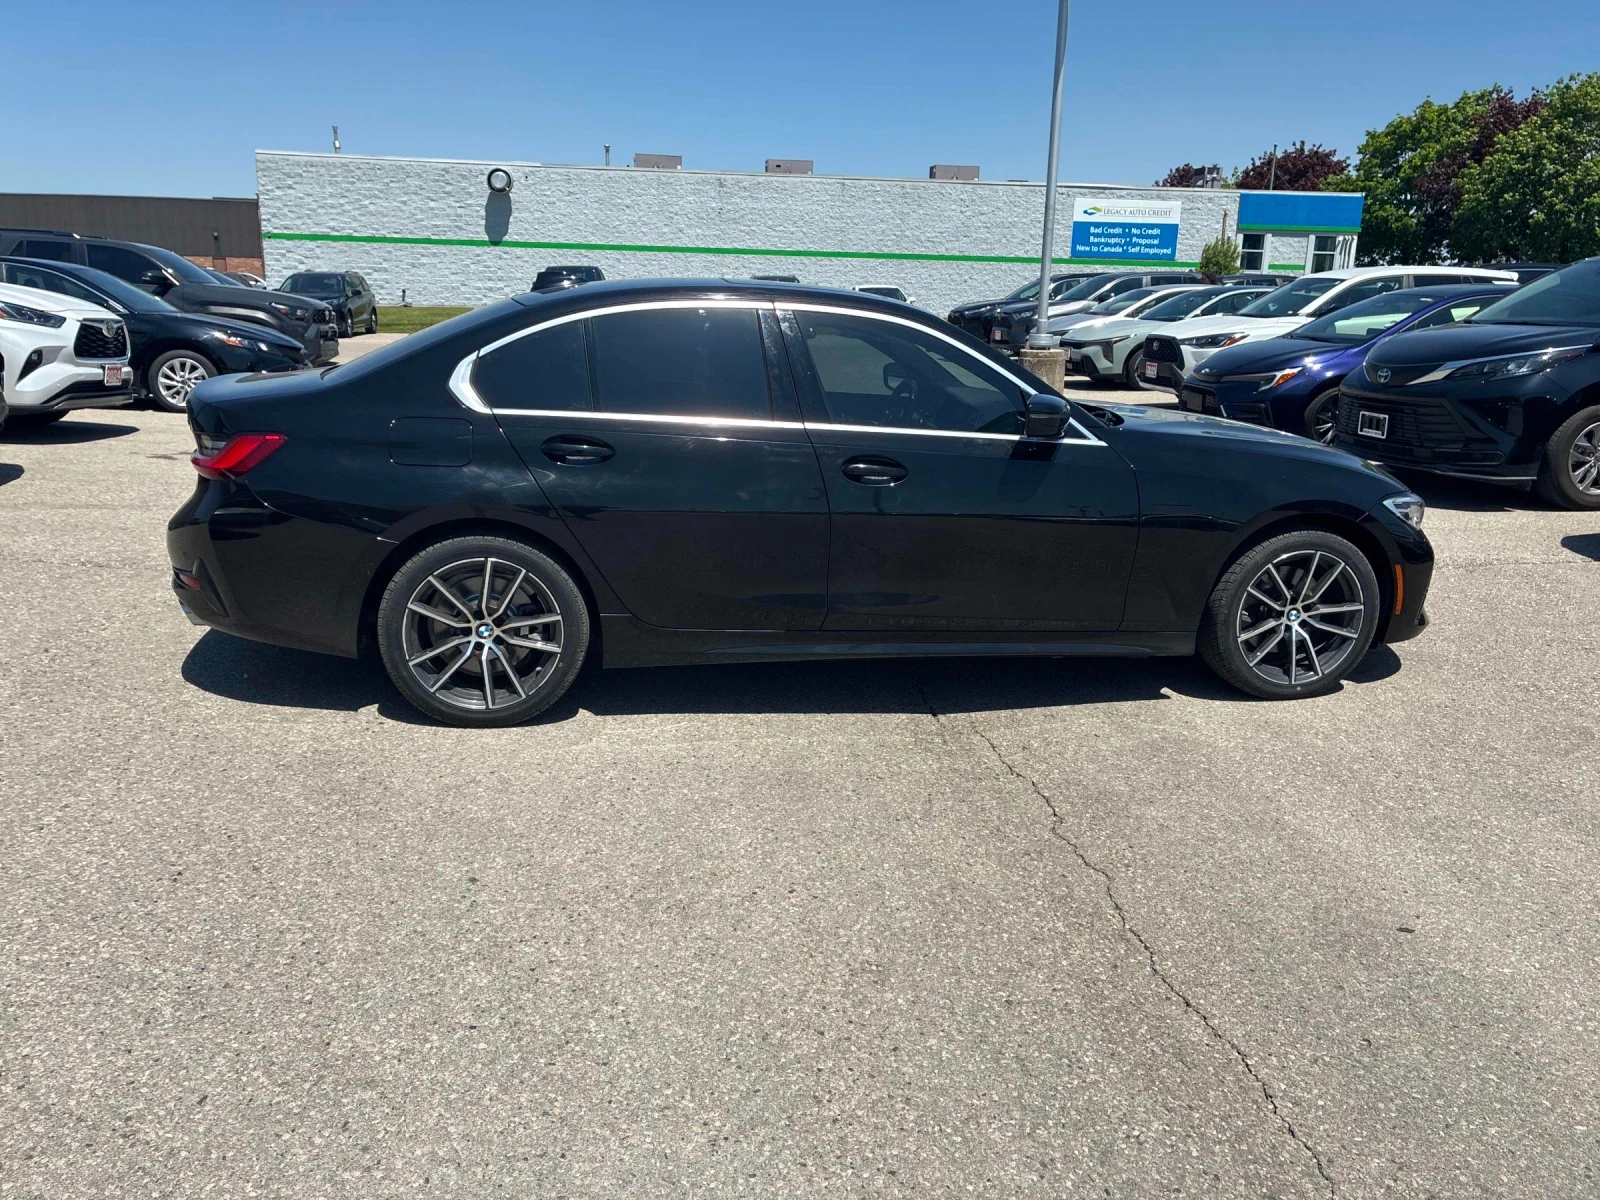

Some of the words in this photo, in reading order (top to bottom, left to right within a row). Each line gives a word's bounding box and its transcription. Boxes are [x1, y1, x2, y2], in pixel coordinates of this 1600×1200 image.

[1148, 209, 1172, 217] CREDIT
[1090, 226, 1102, 234] Bad
[1103, 226, 1123, 234] Credit
[1131, 227, 1141, 235] No
[1141, 227, 1161, 235] Credit
[1089, 236, 1125, 245] Bankruptcy
[1132, 237, 1160, 245] Proposal
[1076, 244, 1090, 252] New
[1099, 245, 1123, 253] Canada
[1128, 245, 1140, 253] Self
[1140, 246, 1172, 255] Employed
